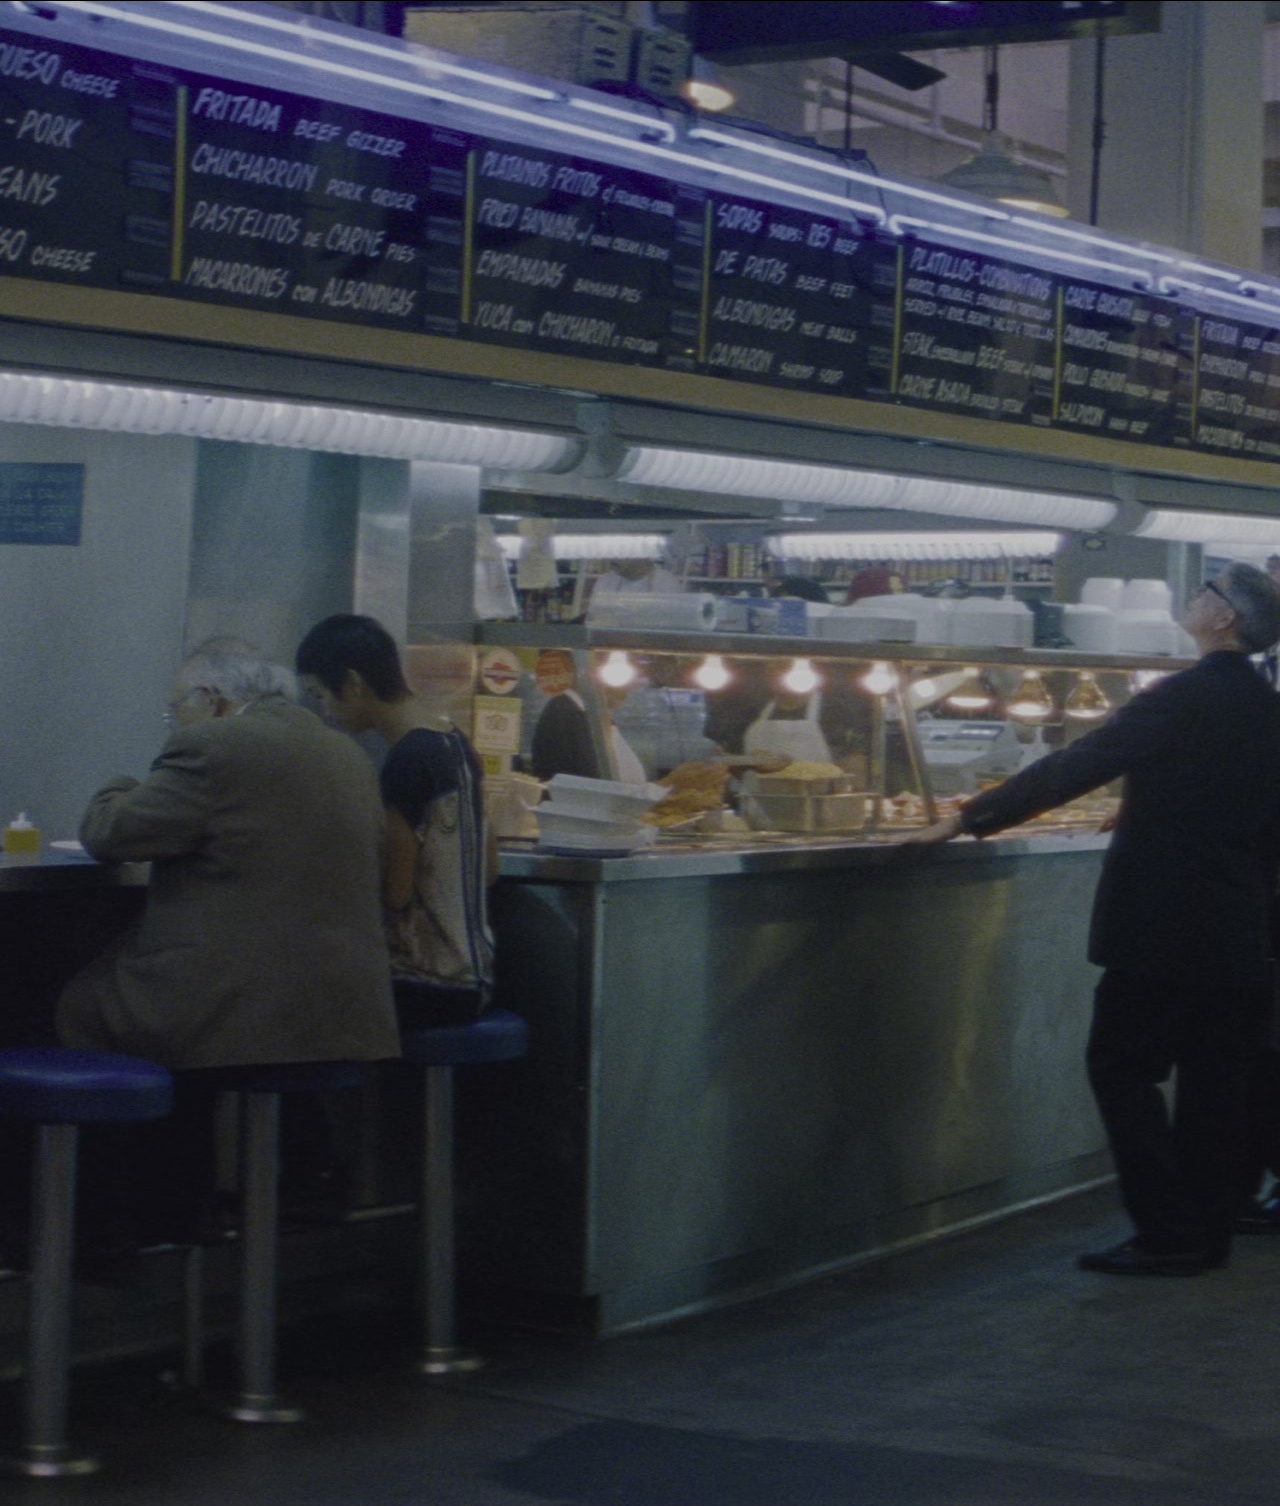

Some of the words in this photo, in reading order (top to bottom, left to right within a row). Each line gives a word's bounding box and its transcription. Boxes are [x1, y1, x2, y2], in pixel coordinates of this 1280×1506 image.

[60, 69, 121, 99] CHEESE
[16, 109, 83, 149] PORK
[192, 87, 283, 133] FRITADA
[292, 118, 343, 142] BEEF
[190, 142, 318, 193] CHICHARRON
[324, 178, 366, 201] PORK
[369, 186, 418, 212] ORDER
[479, 150, 554, 189] PLATANOS
[551, 166, 603, 198] FRITOS
[187, 200, 303, 245] PASTELITOS
[302, 232, 322, 249] DE
[324, 223, 386, 258] CARNE
[384, 242, 417, 263] PIES
[477, 197, 520, 230] FRIED
[717, 202, 766, 234] SOPAS
[30, 245, 96, 272] CHEESE
[475, 249, 568, 289] EMPANADAS
[714, 249, 739, 276] DE
[741, 254, 789, 286] PATAS
[795, 273, 827, 292] BEEF
[185, 256, 290, 298] MACARRONES
[320, 277, 417, 317] ALBONDIGAS
[473, 301, 514, 331] YUCA
[712, 296, 797, 333] ALBONDIGAS
[708, 342, 774, 374] CAMARON
